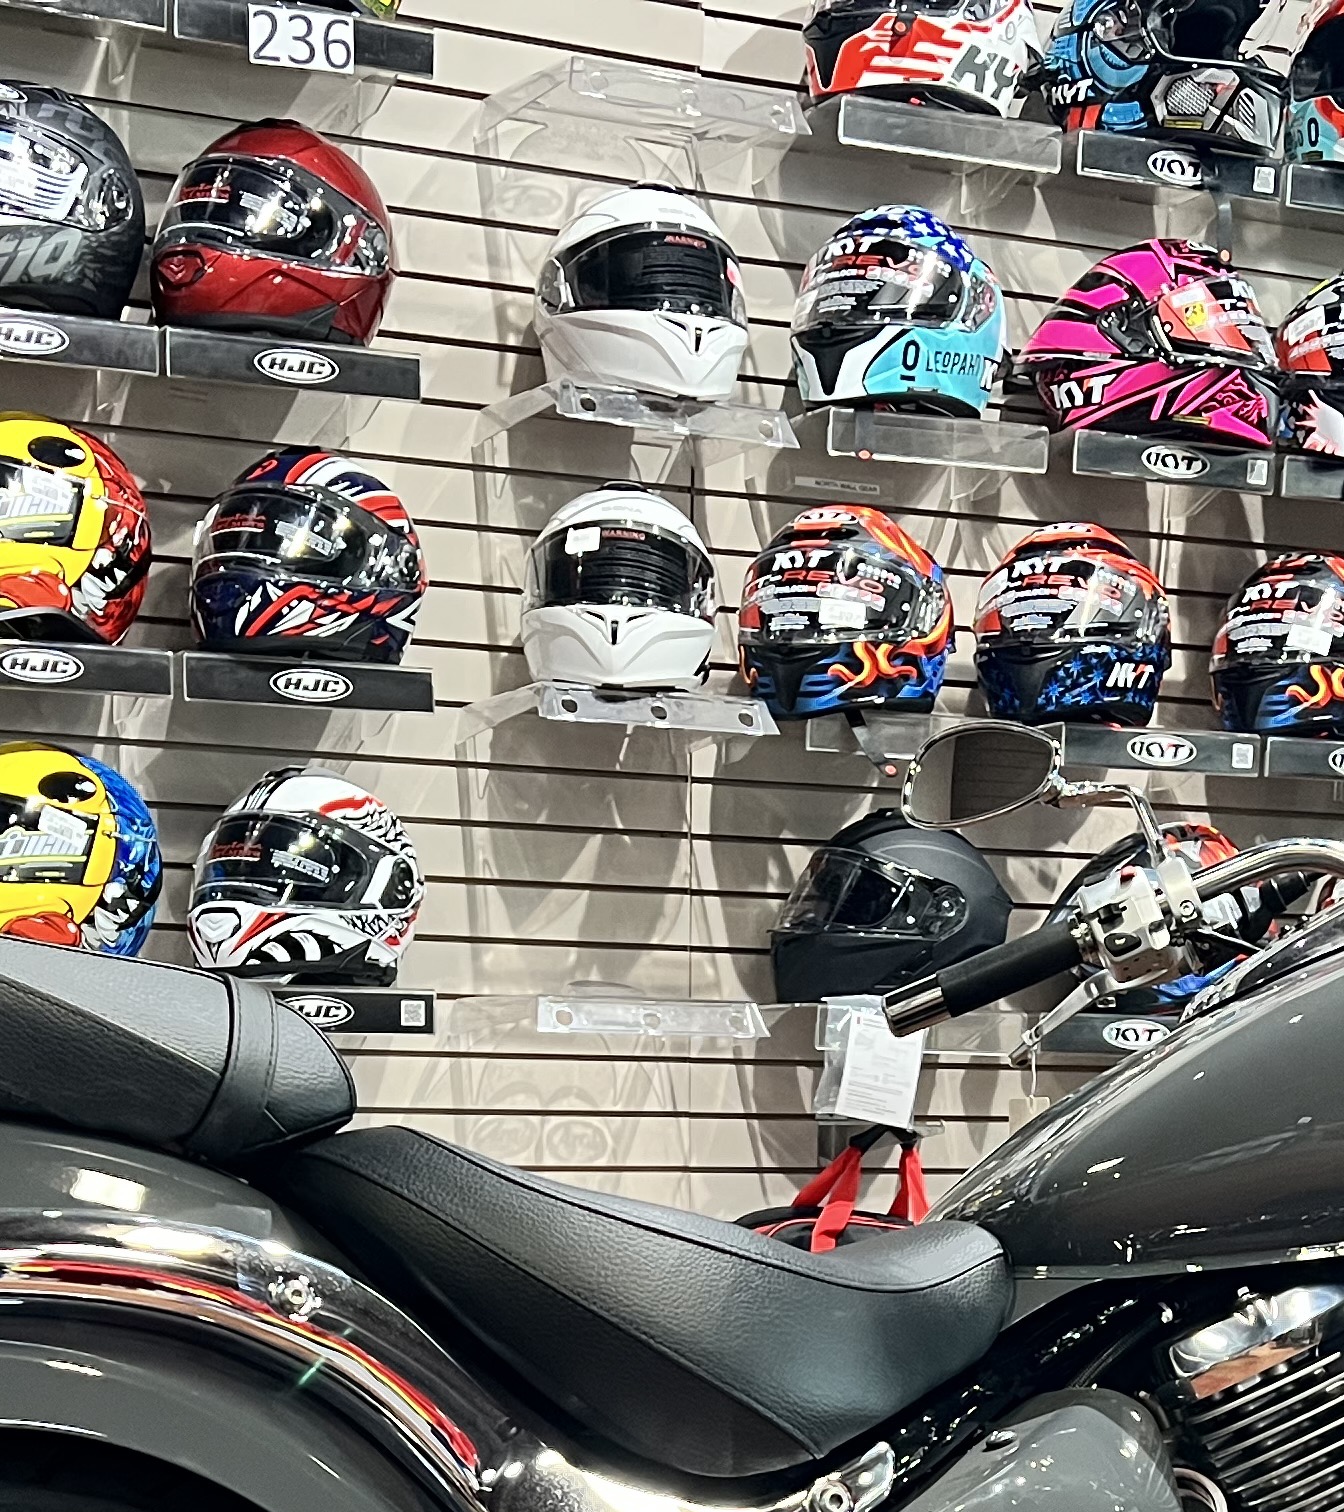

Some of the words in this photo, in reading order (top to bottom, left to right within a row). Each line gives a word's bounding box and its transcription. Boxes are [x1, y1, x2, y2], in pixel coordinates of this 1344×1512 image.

[253, 10, 352, 70] 236
[269, 358, 326, 377] HJC
[1050, 374, 1117, 409] KYT
[859, 484, 878, 493] GEAR
[602, 529, 646, 541] WARNING
[772, 550, 834, 572] KYT
[1242, 581, 1300, 603] KYT
[9, 657, 71, 675] HJC
[1106, 662, 1155, 688] KYT
[284, 676, 340, 694] HJC
[1131, 741, 1187, 760] KYT
